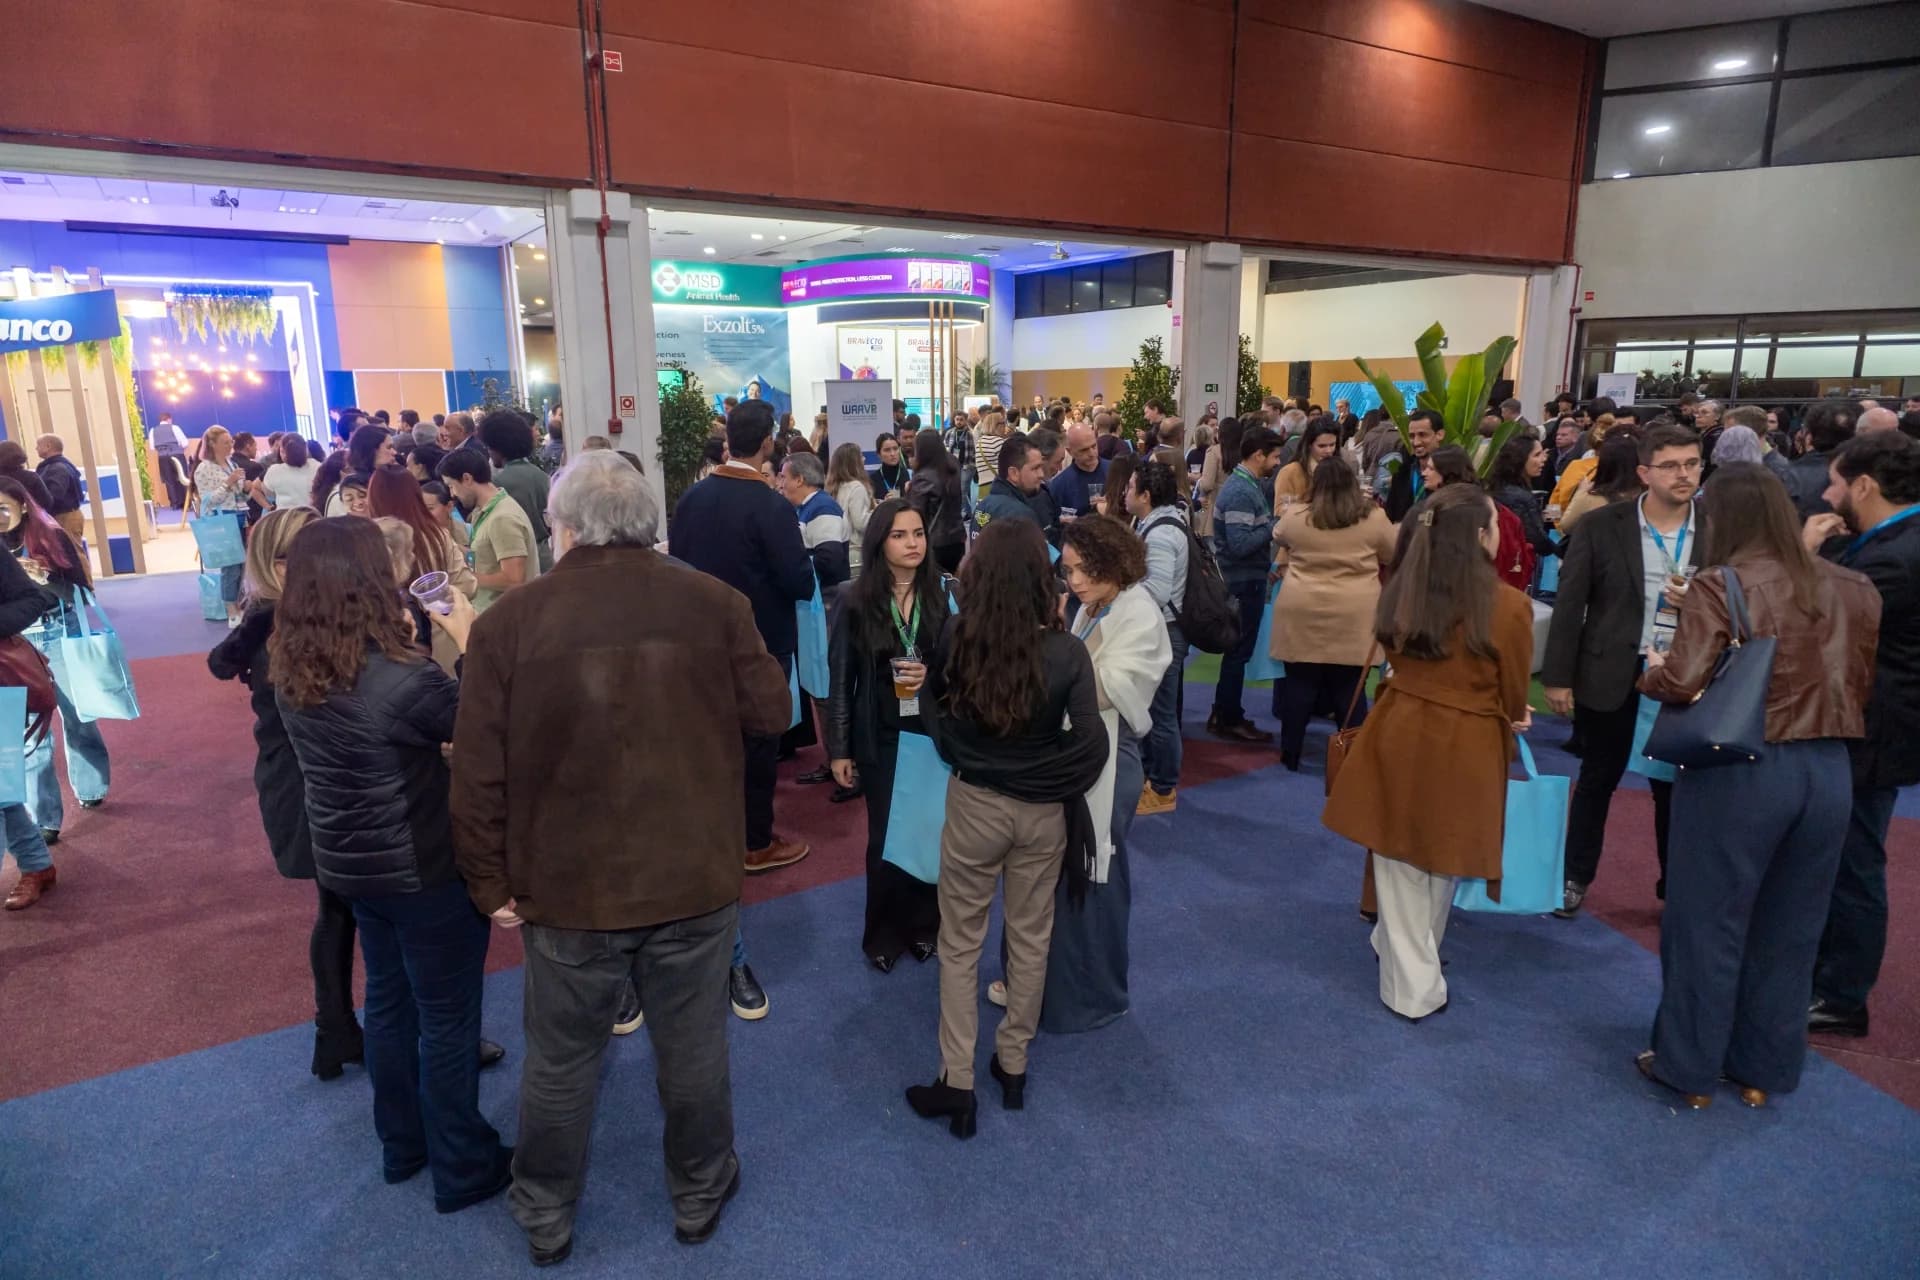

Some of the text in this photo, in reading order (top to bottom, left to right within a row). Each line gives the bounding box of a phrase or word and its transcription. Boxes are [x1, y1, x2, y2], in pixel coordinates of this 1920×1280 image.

[687, 274, 720, 288] MSD
[686, 291, 740, 301] Animal Health
[847, 337, 883, 345] BRAVECTO
